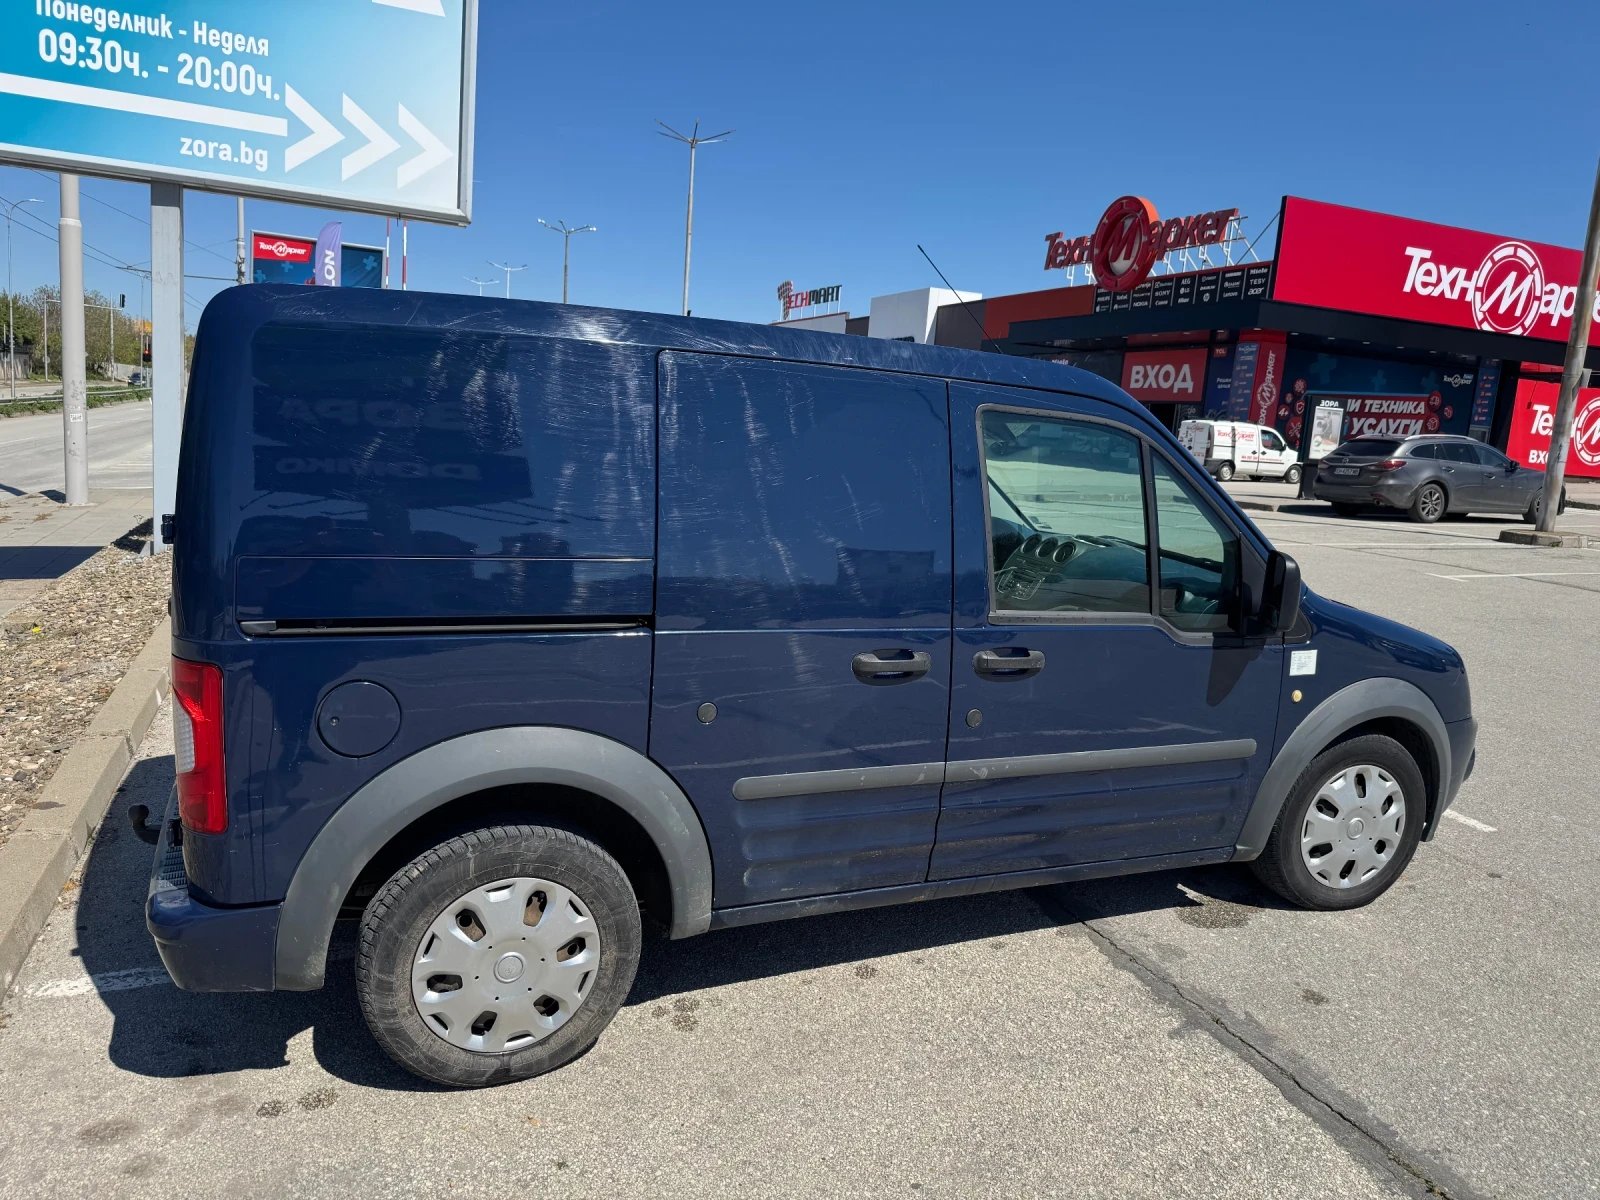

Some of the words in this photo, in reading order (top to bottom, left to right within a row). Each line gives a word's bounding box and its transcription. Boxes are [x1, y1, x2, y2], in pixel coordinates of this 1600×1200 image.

[36, 0, 172, 39] Понеделник
[193, 22, 270, 56] Неделя
[38, 29, 149, 78] 09:30ч.
[177, 53, 281, 101] 20:00ч.
[179, 136, 269, 172] zora.bg
[1130, 363, 1195, 394] ВХОД
[1319, 399, 1339, 408] ЗОРА
[1364, 399, 1426, 414] ТЕХНИКА
[1350, 418, 1424, 436] УСЛУГИ
